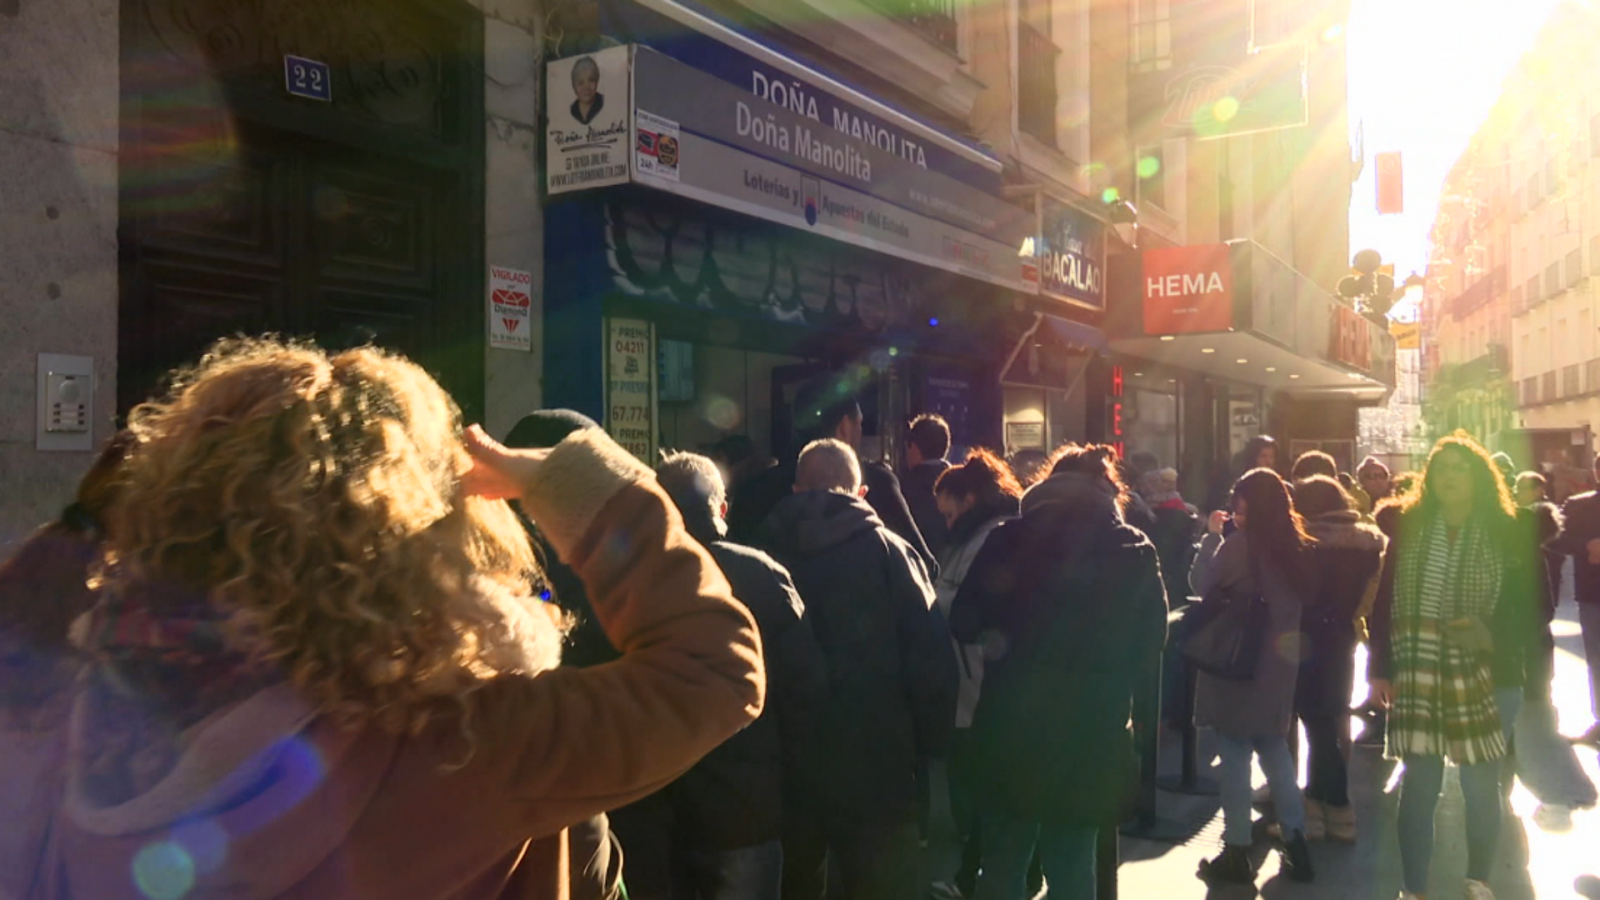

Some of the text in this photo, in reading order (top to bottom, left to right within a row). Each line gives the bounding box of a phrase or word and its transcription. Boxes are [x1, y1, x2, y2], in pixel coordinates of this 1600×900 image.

[294, 64, 322, 91] 22
[752, 70, 928, 170] DOÑA MANOLITA
[736, 101, 871, 182] Doña Manolita
[744, 169, 790, 200] Loterías
[791, 189, 799, 207] y
[822, 196, 865, 224] Apuestas
[491, 267, 531, 285] VIGILADO
[1043, 247, 1101, 295] BACALAO
[1147, 271, 1224, 298] HEMA
[615, 340, 645, 354] 04211
[612, 405, 649, 421] 67.774
